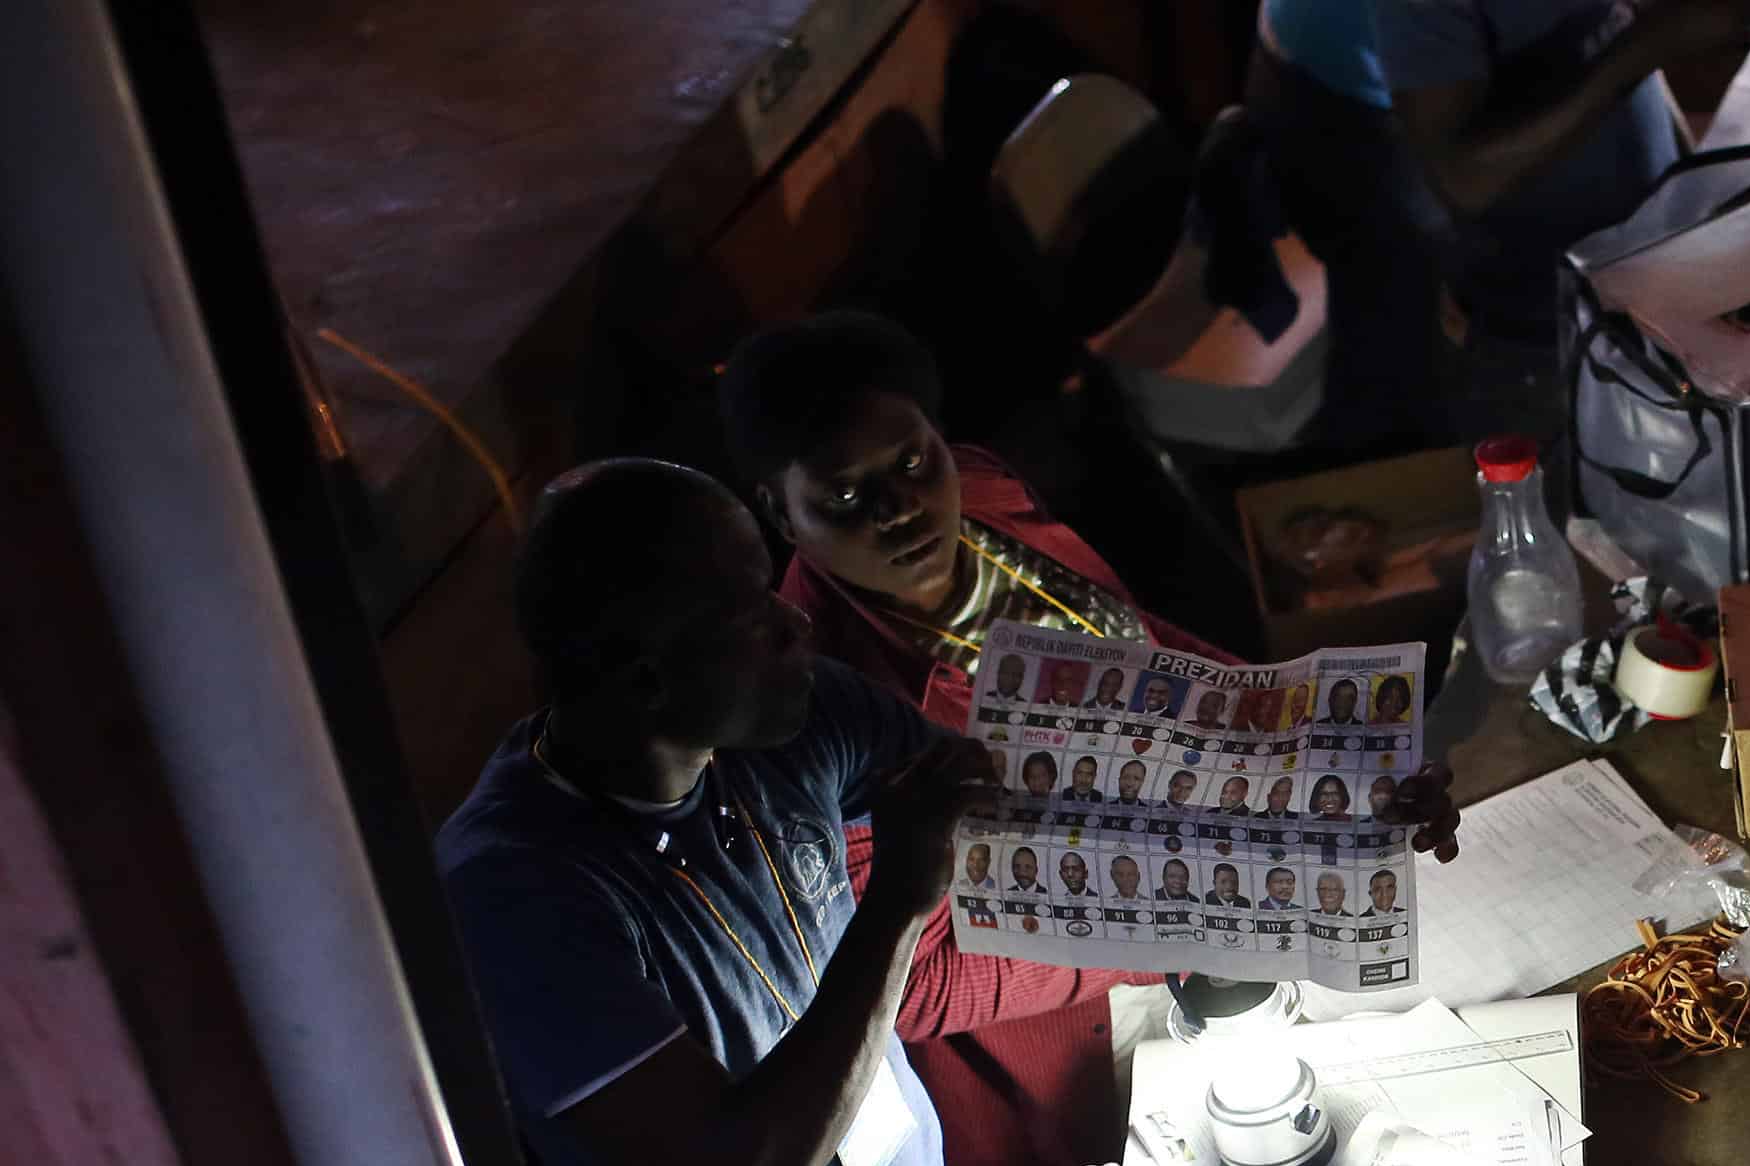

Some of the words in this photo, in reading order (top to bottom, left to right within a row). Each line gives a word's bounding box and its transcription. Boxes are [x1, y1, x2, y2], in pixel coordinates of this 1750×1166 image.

[1154, 655, 1273, 689] PREZIDAN
[1115, 911, 1125, 921] 91
[1213, 919, 1229, 929] 102
[1367, 929, 1384, 940] 137
